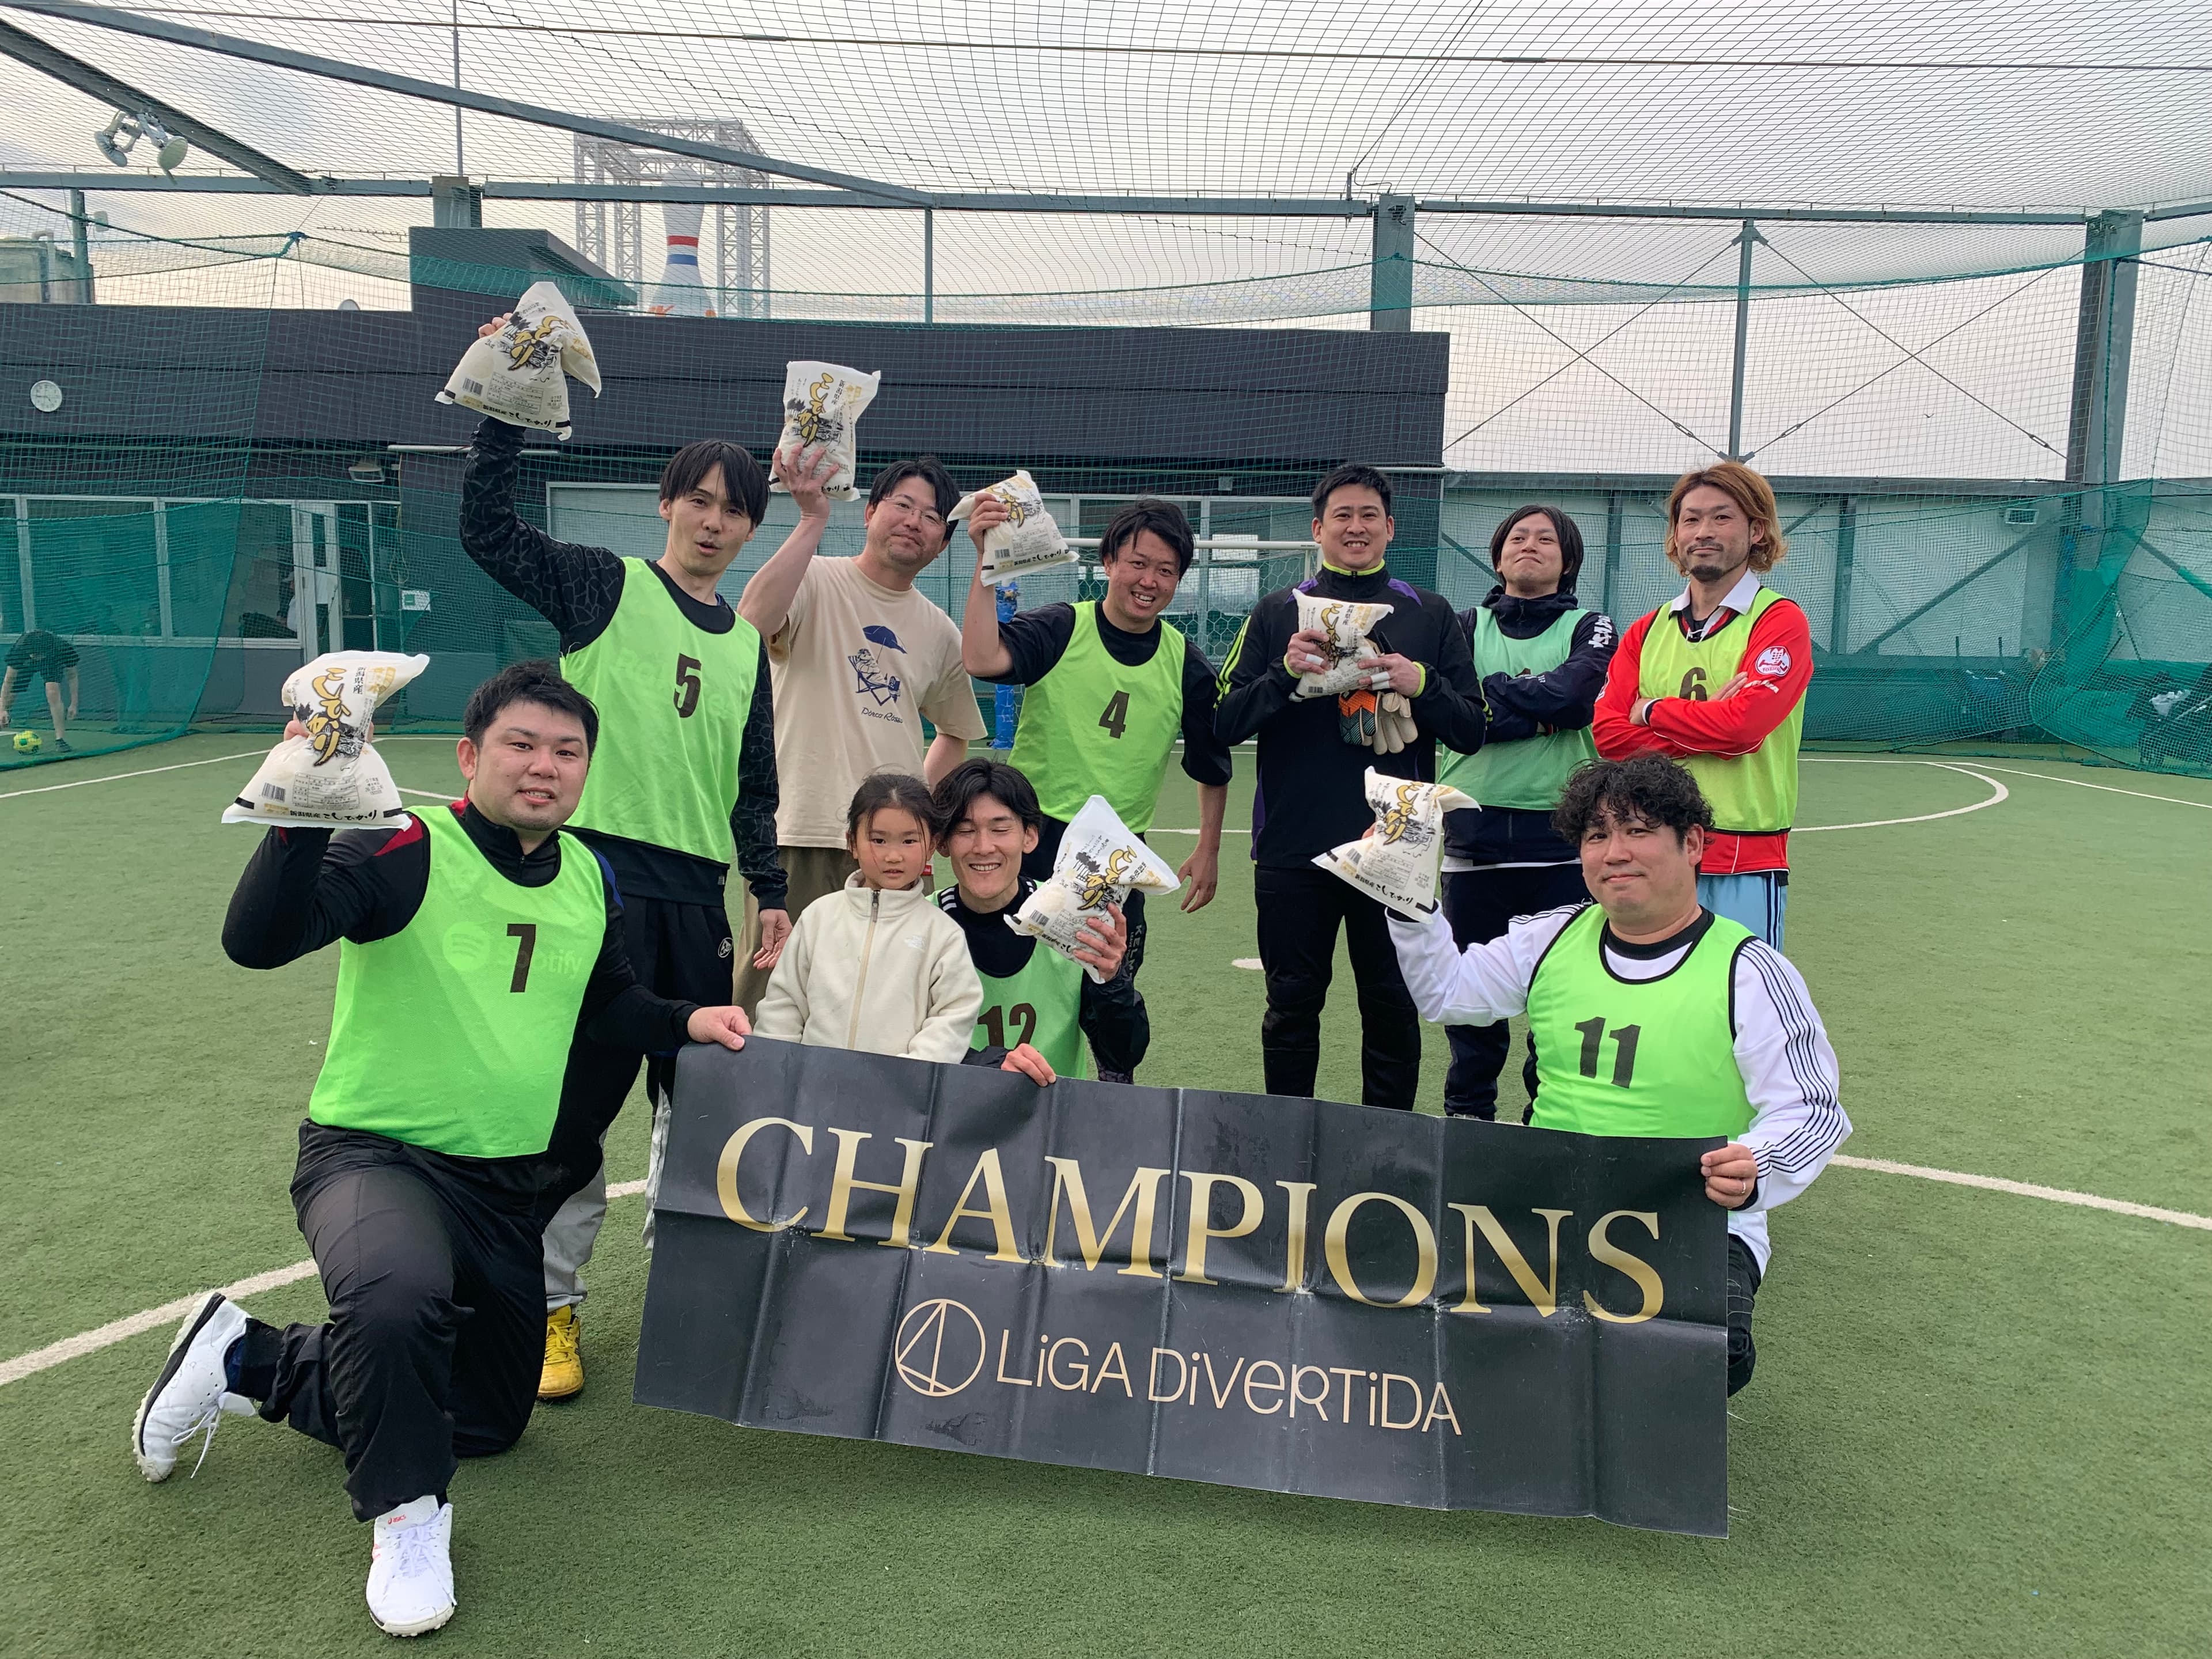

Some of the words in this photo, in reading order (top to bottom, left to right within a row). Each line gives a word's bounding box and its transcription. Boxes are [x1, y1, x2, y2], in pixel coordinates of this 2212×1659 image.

[306, 667, 351, 767] こしひかり
[673, 653, 702, 718] 5
[1098, 690, 1130, 740] 4
[1679, 666, 1708, 702] 6
[1077, 844, 1138, 911] こしひかり
[506, 923, 537, 993] 7
[977, 1002, 1039, 1052] 12
[1574, 1016, 1642, 1089] 11
[717, 1116, 1664, 1325] CHAMPIONS
